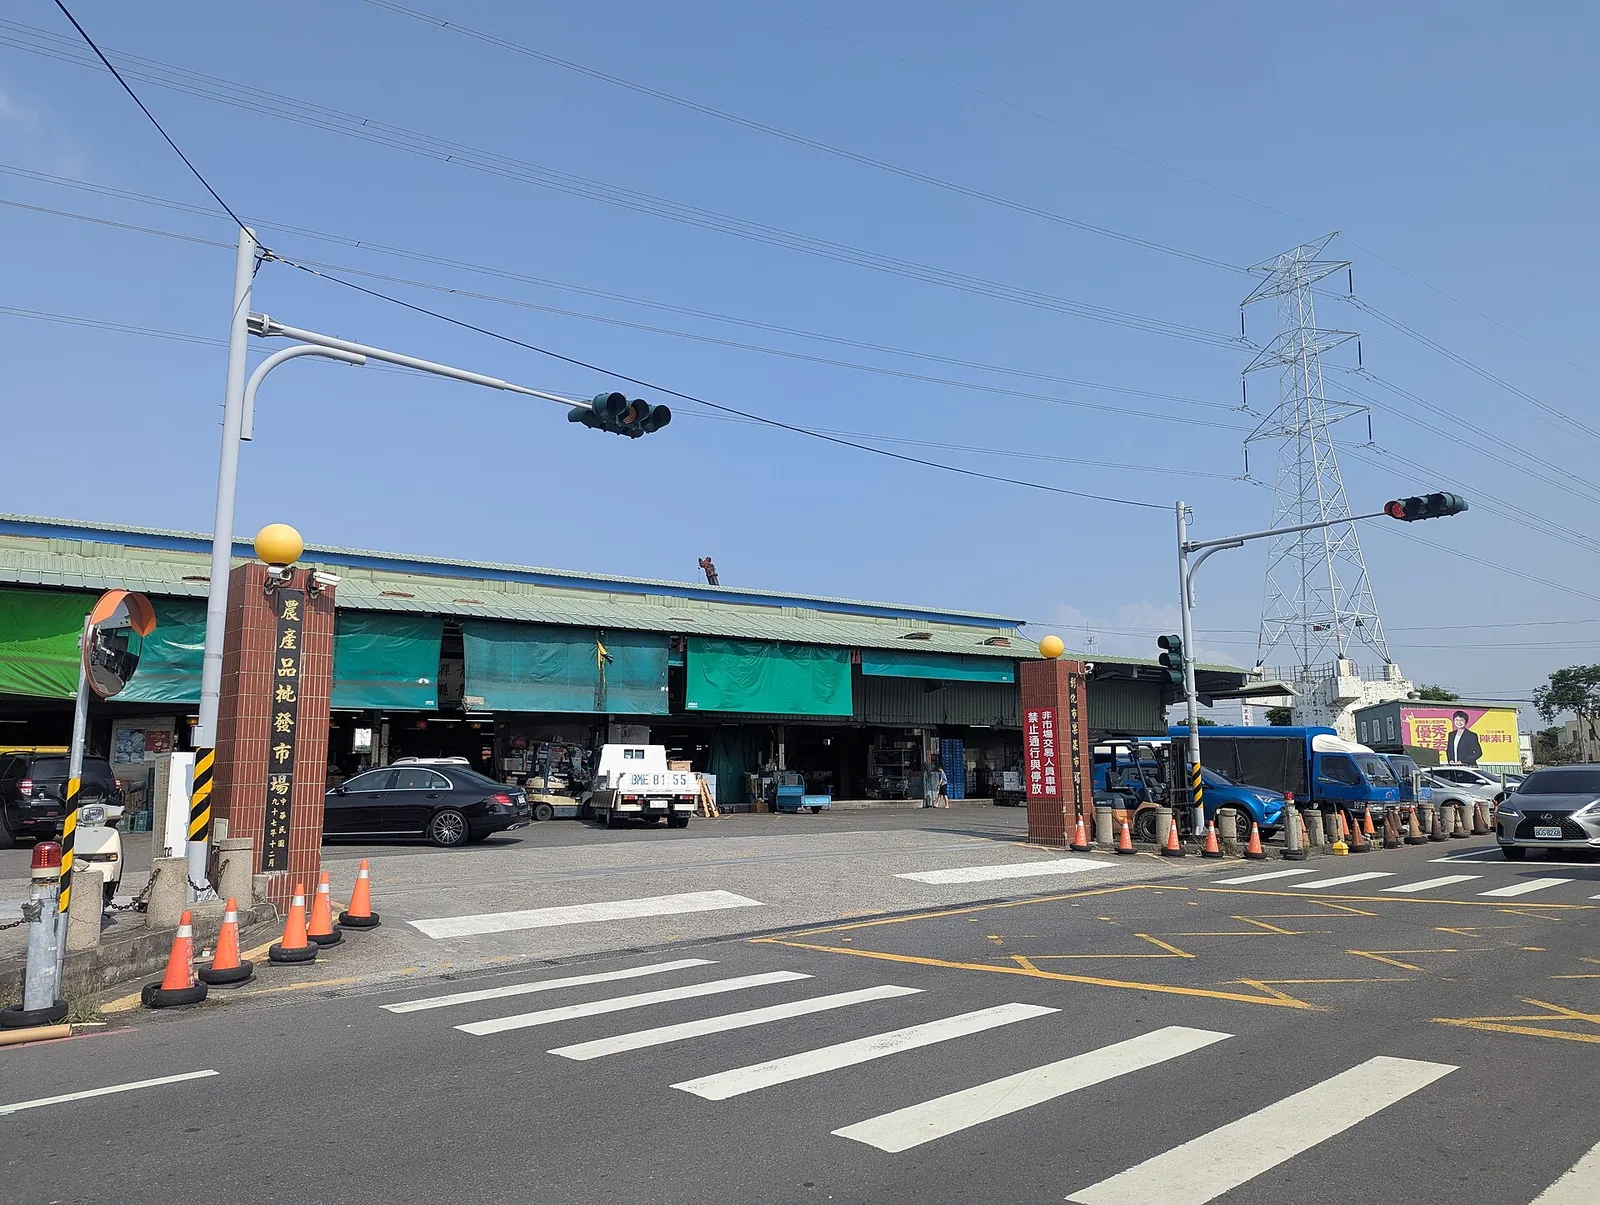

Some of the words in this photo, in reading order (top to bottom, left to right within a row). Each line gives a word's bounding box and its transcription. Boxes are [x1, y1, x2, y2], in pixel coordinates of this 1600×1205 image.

[270, 599, 300, 795] 農產品批發市場
[1027, 711, 1043, 795] 禁止通行與停放
[1041, 710, 1057, 795] 非市場交易人員車輛
[1415, 724, 1448, 739] 優秀
[1479, 734, 1512, 743] 陳素月
[631, 774, 649, 785] BME
[653, 774, 665, 785] 81
[673, 774, 687, 785] 55
[268, 797, 280, 867] 九十七年十二月
[277, 797, 287, 848] 中華民國
